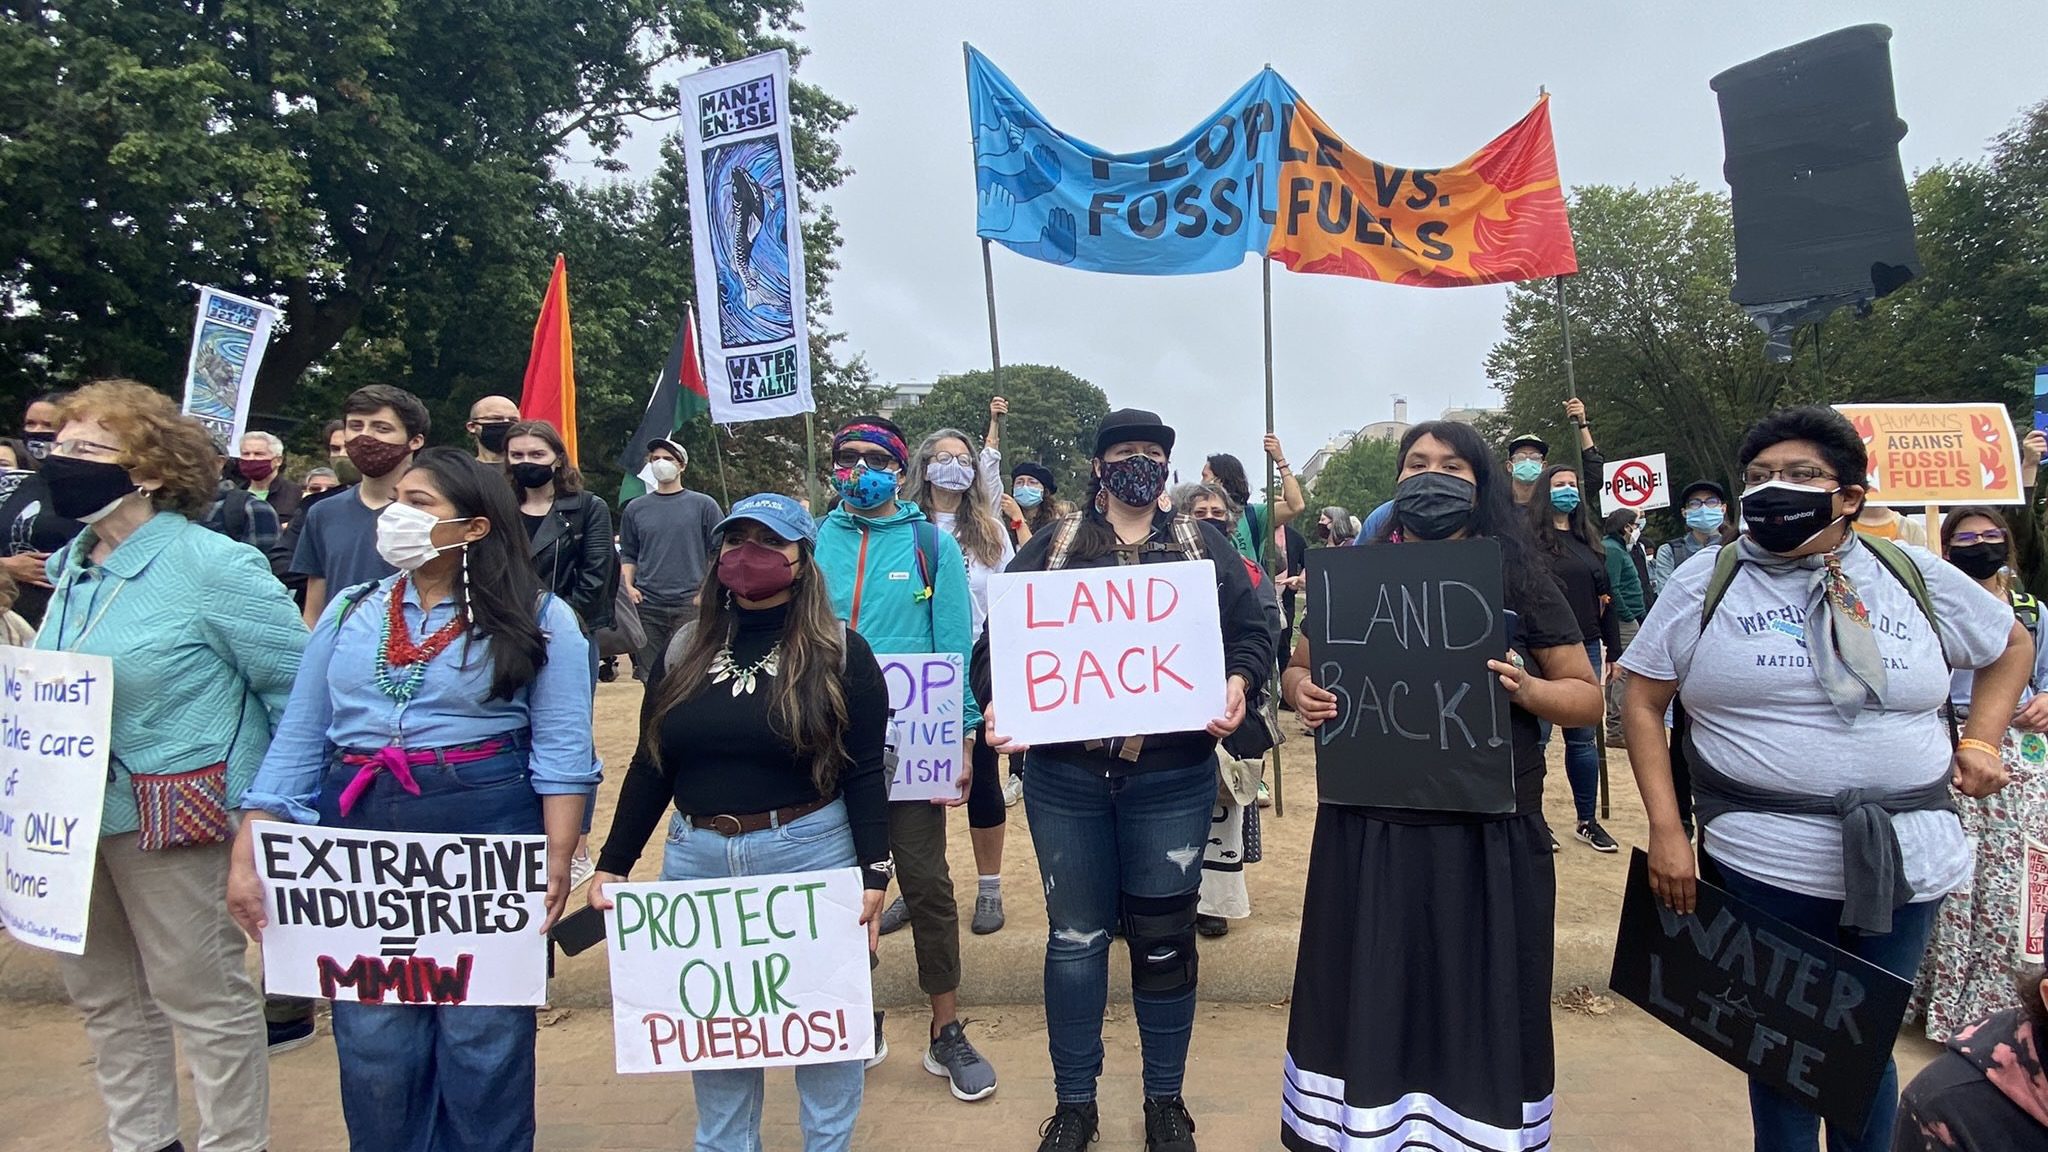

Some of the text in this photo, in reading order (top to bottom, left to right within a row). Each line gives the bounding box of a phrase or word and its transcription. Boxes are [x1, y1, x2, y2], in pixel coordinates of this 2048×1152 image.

[701, 82, 768, 115] MANI:
[703, 101, 771, 138] EN:ISE
[1088, 162, 1277, 239] FOSSIL
[1373, 161, 1450, 210] VS.
[729, 349, 796, 380] WATER
[733, 372, 796, 400] IS ALIVE
[1875, 412, 1963, 433] HUMANS
[1888, 434, 1964, 450] AGAINST
[1888, 451, 1970, 469] FOSSIL
[1890, 469, 1972, 489] FUELS
[1783, 508, 1816, 522] flashbay
[1026, 577, 1179, 629] LAND
[1323, 569, 1494, 650] LAND
[3, 665, 97, 706] We must
[1025, 644, 1195, 712] BACK
[1320, 661, 1504, 749] BACK!
[39, 733, 95, 758] care
[4, 767, 19, 797] of
[25, 811, 79, 850] ONLY
[5, 852, 49, 899] home
[261, 832, 548, 893] EXTRACTIVE
[275, 886, 530, 936] INDUSTRIES
[615, 881, 827, 951] PROTECT
[316, 953, 475, 1006] MMIW
[679, 952, 798, 1021] OUR
[1654, 895, 1866, 1046] WATER
[641, 1009, 849, 1066] PUEBLOS!
[1649, 953, 1826, 1099] LIFE
